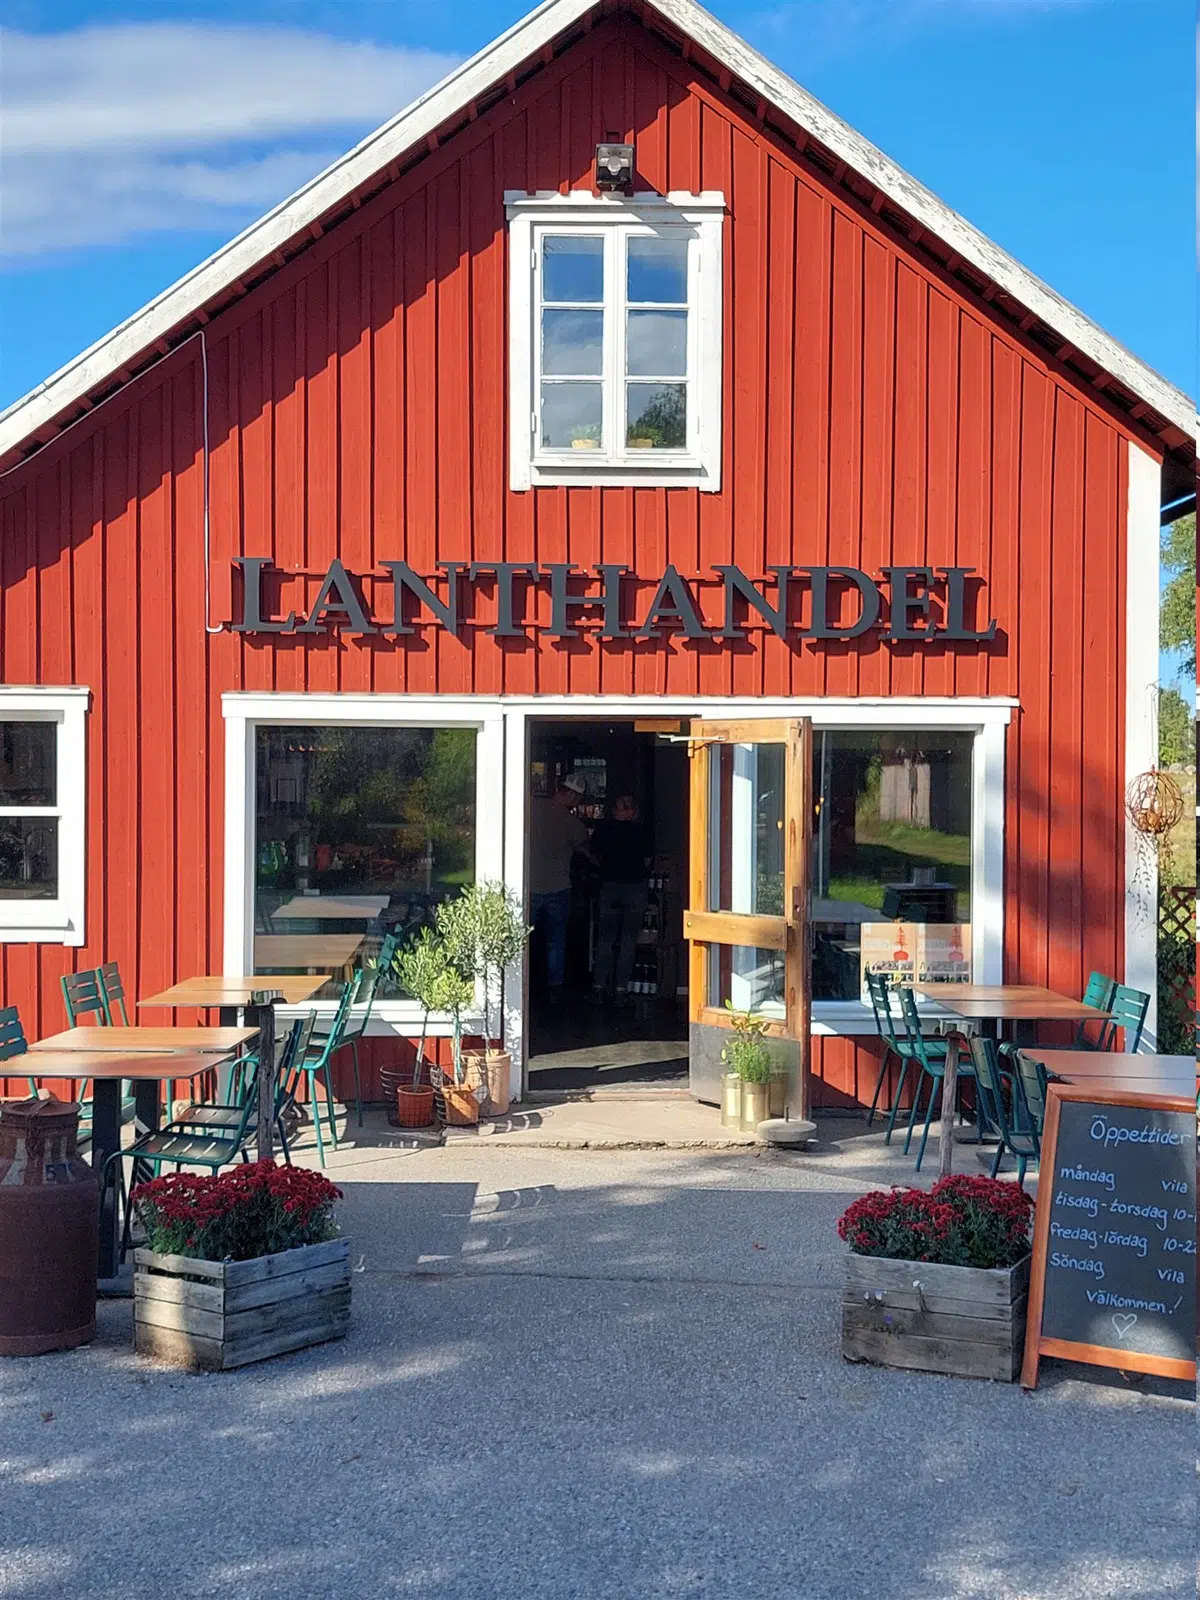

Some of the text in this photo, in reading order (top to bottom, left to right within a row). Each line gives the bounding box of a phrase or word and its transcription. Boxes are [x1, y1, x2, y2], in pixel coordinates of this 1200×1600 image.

[231, 557, 997, 641] LANTHANDEL
[1090, 1114, 1192, 1148] Öppettider
[1060, 1164, 1188, 1194] måndag vila
